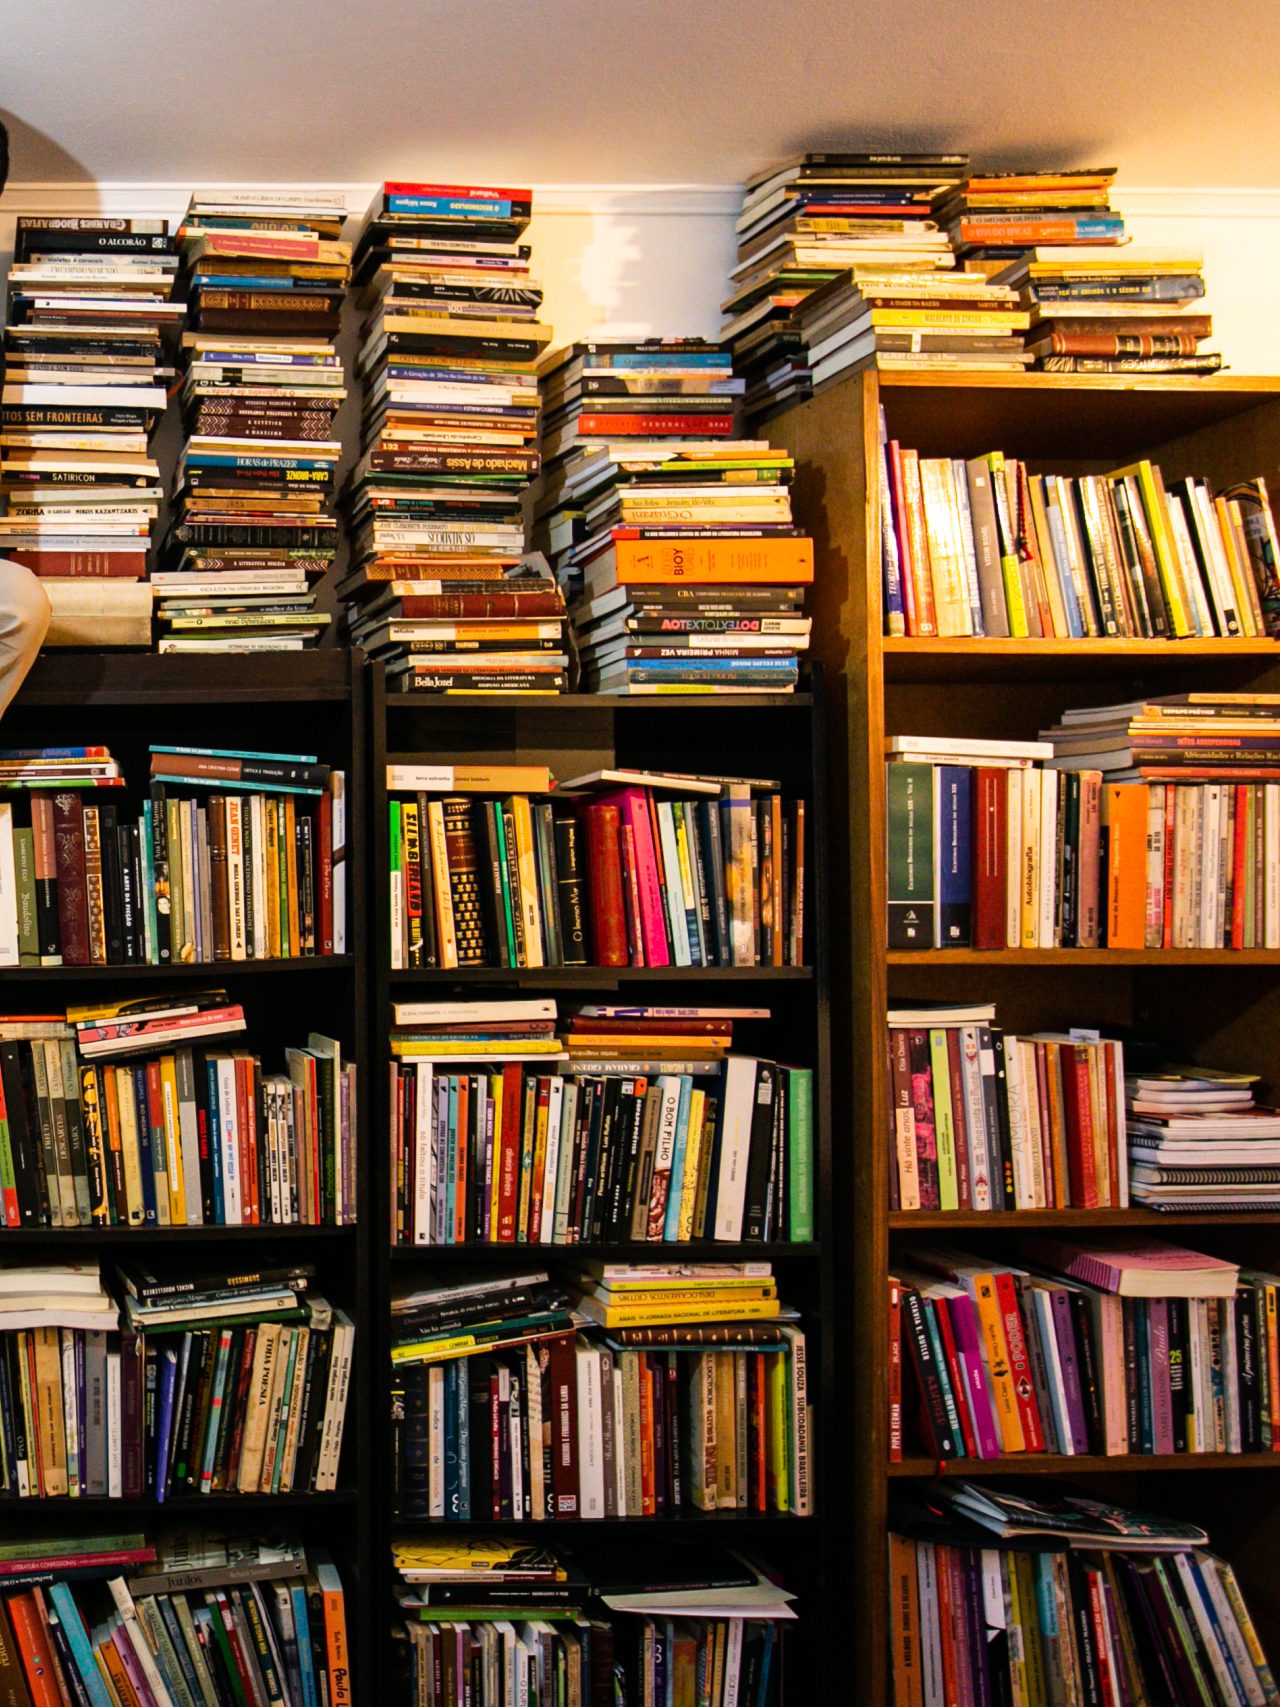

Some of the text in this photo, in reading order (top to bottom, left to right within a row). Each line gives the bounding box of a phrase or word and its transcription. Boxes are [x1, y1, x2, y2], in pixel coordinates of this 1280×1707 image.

[108, 237, 146, 246] ALCORÃO
[25, 410, 43, 422] SEM
[46, 412, 103, 423] FRONTEIRAS
[52, 473, 95, 482] SATIRICON
[236, 458, 260, 468] HORAS
[271, 458, 298, 469] PRAZER
[446, 458, 527, 470] Machado de Assis
[631, 510, 692, 521] O Guarani
[674, 548, 684, 576] BIOY
[415, 677, 453, 687] Bella Jozef
[1236, 752, 1264, 760] Relações
[230, 801, 239, 856] JEAN GENET
[1025, 846, 1033, 906] Autobiografia
[896, 1033, 906, 1072] Elsa Osorio
[660, 1097, 675, 1162] O BOM FILHO
[899, 1089, 913, 1173] Há vinte anos, Luz
[1007, 1084, 1023, 1153] AMORA
[58, 1112, 68, 1160] DESCARTES
[1008, 1312, 1023, 1360] PODER
[1170, 1350, 1182, 1364] 25
[257, 1337, 274, 1407] TODA POESIA
[167, 1575, 202, 1587] Juntos
[333, 1668, 346, 1699] Paulo
